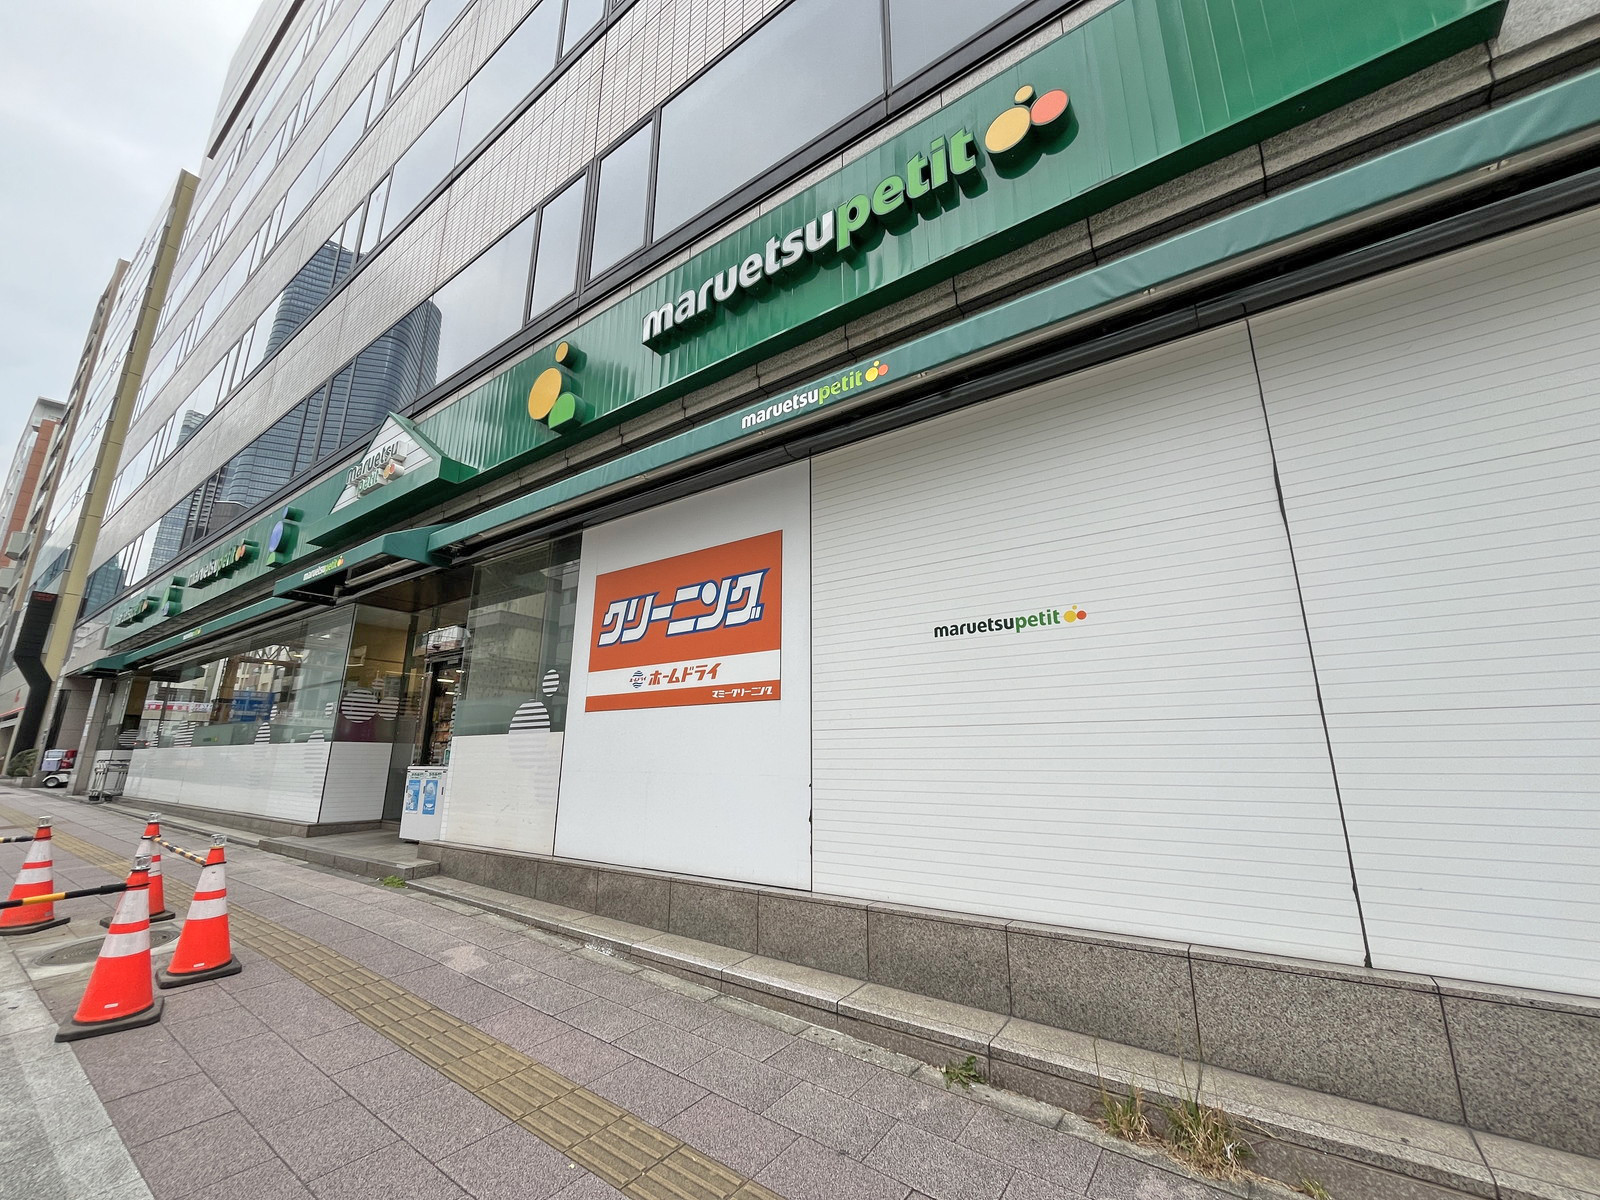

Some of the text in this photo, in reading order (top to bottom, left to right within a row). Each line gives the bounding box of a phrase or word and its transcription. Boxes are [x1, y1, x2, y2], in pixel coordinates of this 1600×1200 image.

[642, 127, 976, 343] maruetsupetit
[741, 370, 863, 429] maruetsupetit
[346, 442, 399, 483] maruetsu
[597, 569, 769, 648] クリーニング
[934, 609, 1060, 637] maruetsupetit
[648, 662, 722, 686] ホームドライ
[712, 686, 773, 698] マミークリーニング
